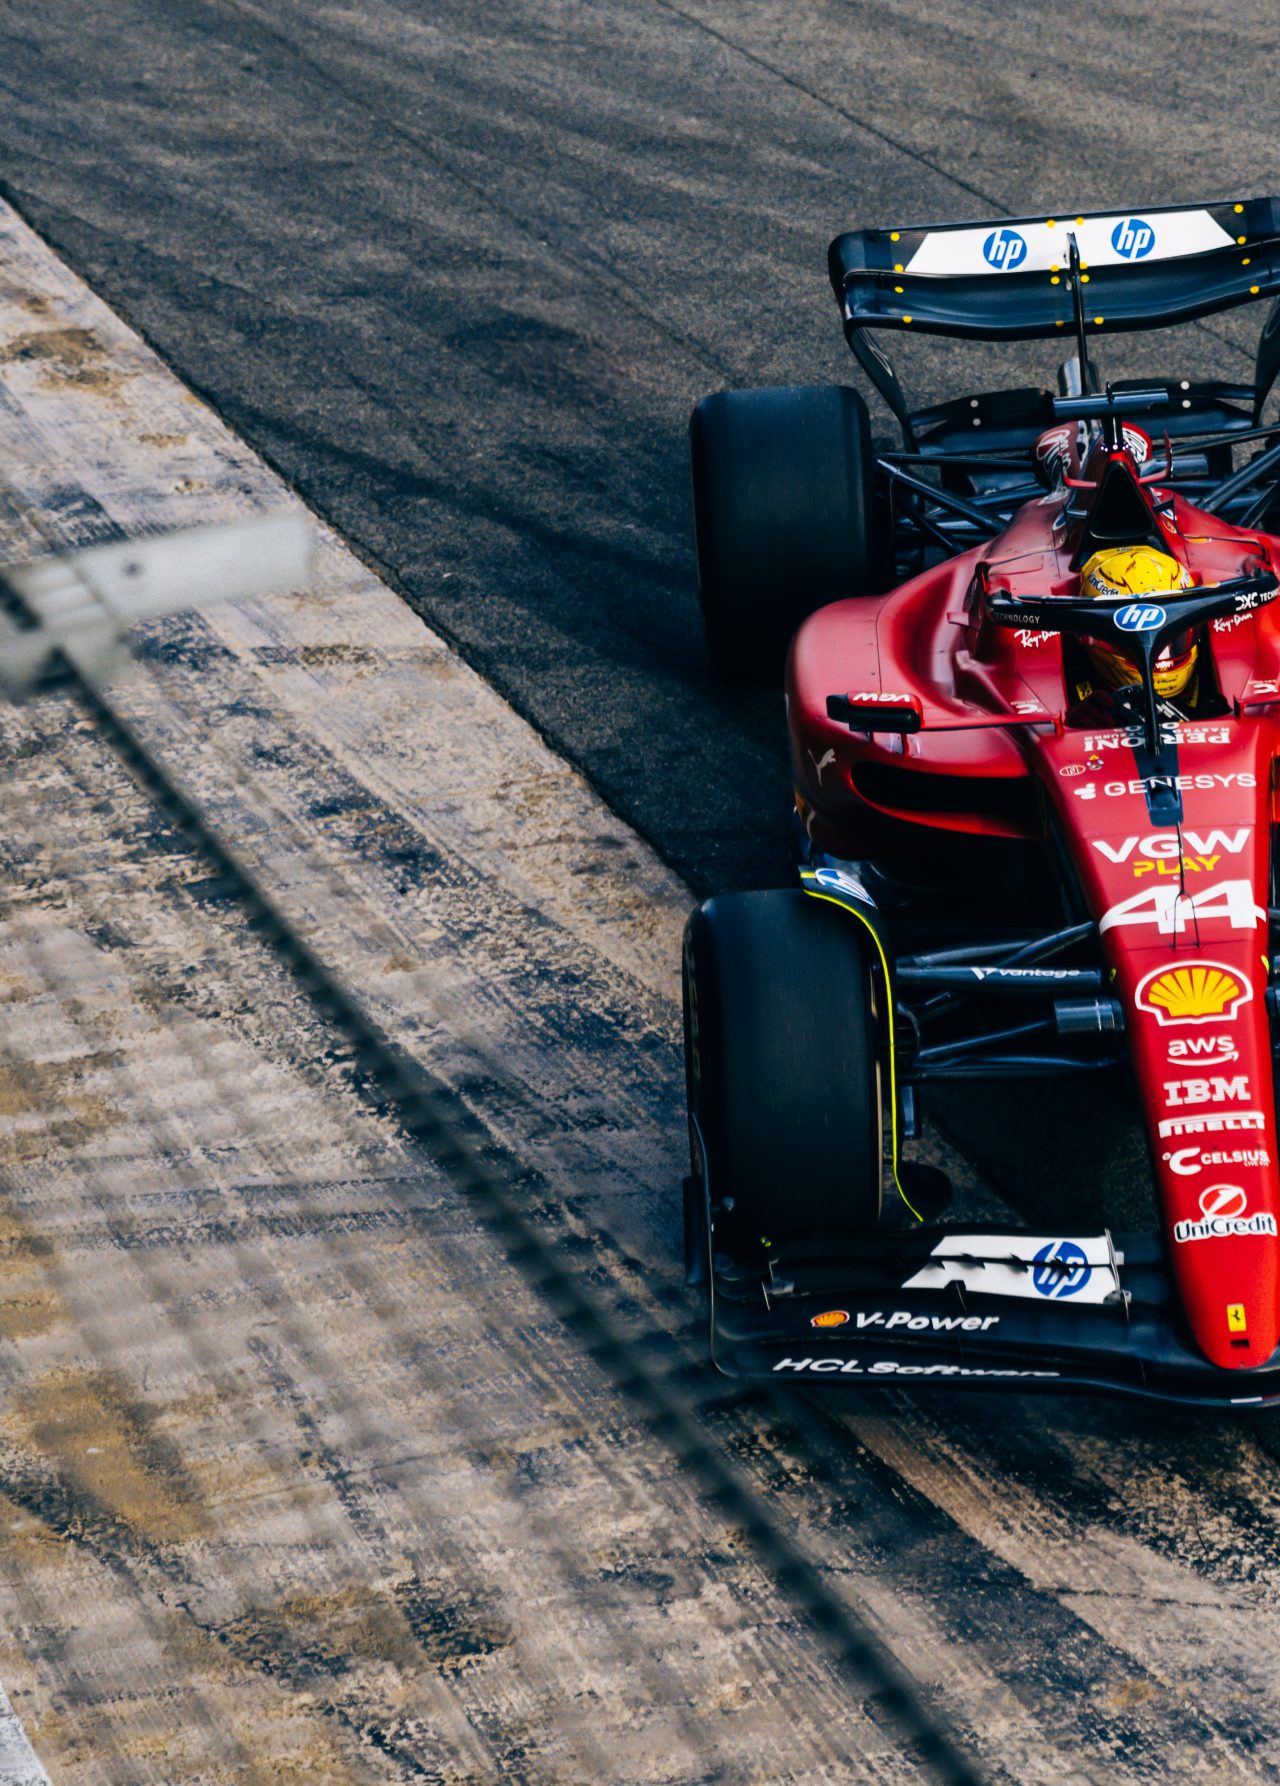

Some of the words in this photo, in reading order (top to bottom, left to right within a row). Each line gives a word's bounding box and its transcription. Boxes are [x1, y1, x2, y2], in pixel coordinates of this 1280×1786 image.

[989, 229, 1024, 270] hp
[1117, 218, 1152, 259] hp
[1122, 604, 1159, 631] hp
[853, 692, 911, 702] VGW
[1103, 773, 1257, 797] GENESYS
[1091, 828, 1251, 864] VGW
[1133, 855, 1222, 878] PLAY
[1099, 879, 1267, 936] 44
[1168, 1035, 1235, 1057] aws
[1163, 1076, 1252, 1107] IBM
[1158, 1111, 1266, 1139] PIRELLI
[1201, 1149, 1270, 1166] CELSIUS
[1175, 1215, 1277, 1240] UniCredit
[1038, 1241, 1086, 1298] hp
[855, 1311, 1000, 1332] V-Power
